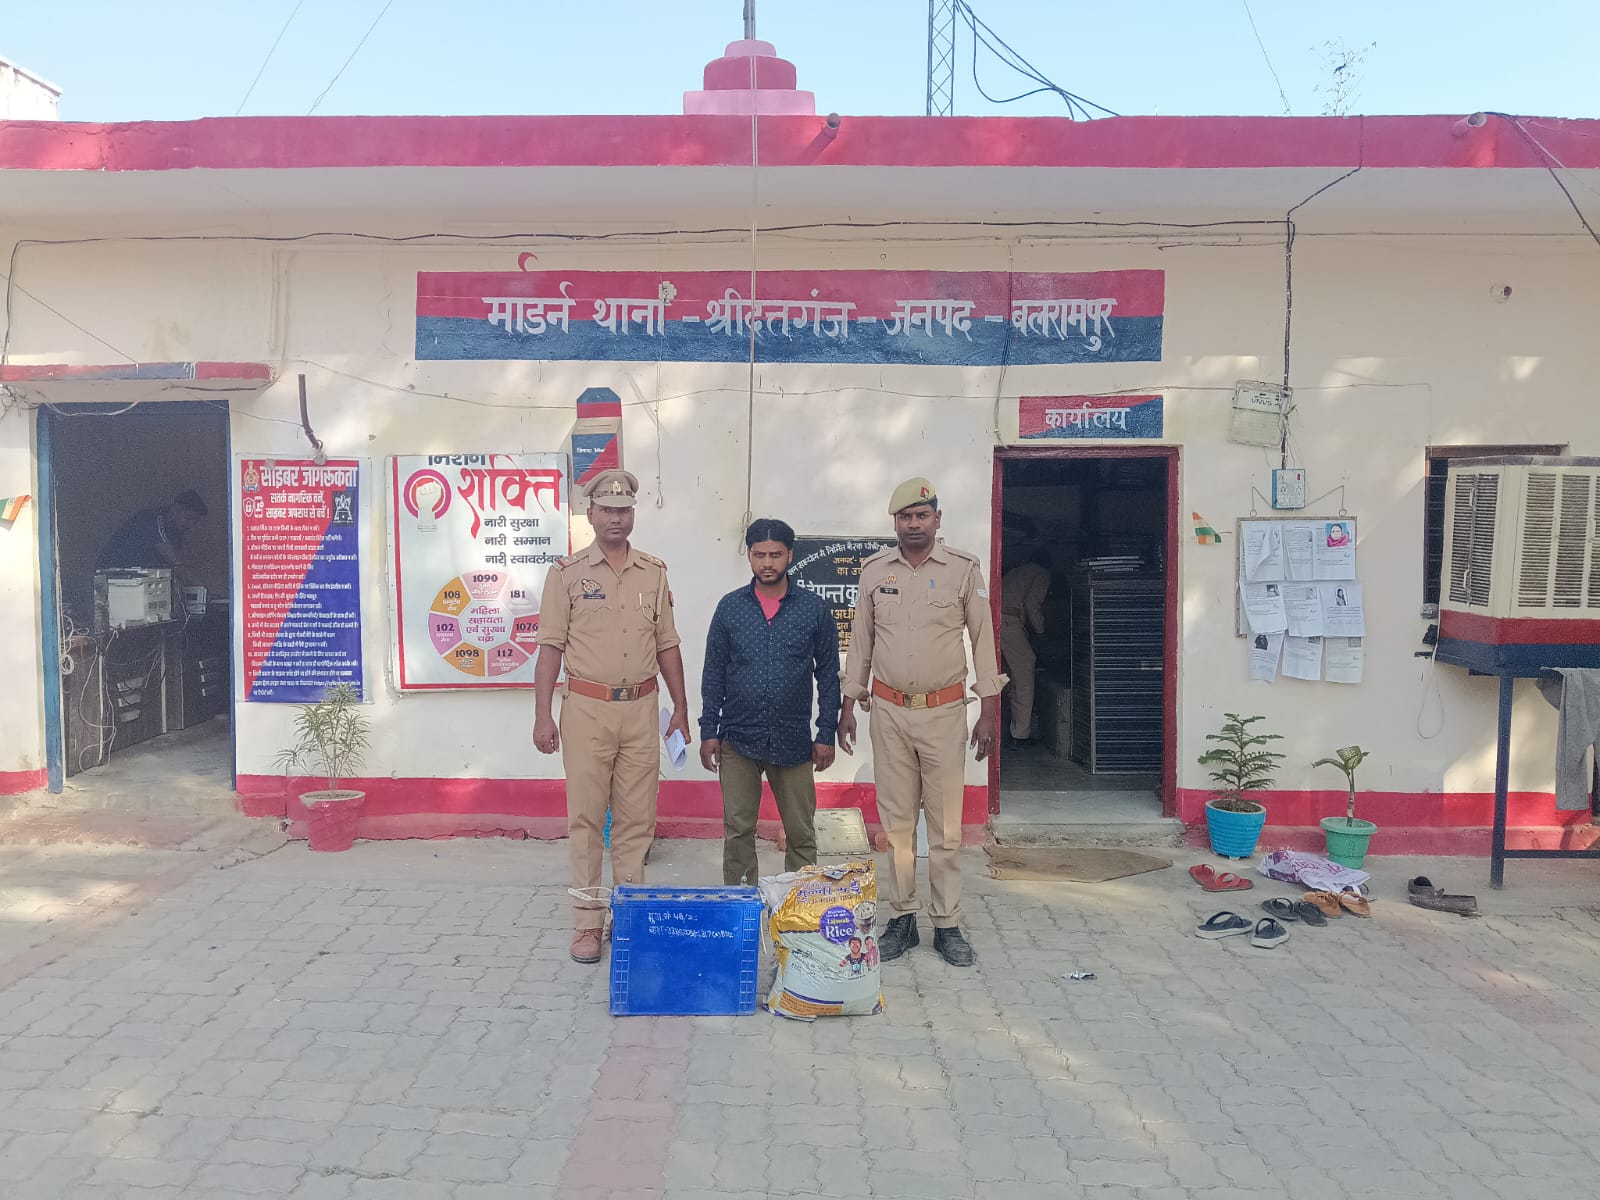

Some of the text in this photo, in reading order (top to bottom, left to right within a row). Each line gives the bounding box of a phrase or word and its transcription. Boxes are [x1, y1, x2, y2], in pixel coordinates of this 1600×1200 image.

[883, 298, 977, 341] जनपद
[1012, 298, 1118, 352] बलरामपुर
[1045, 402, 1131, 430] कार्यालय
[260, 466, 299, 488] साइबर
[457, 454, 563, 539] शक्ति
[484, 515, 539, 531] नारी सुरक्षा
[484, 533, 551, 546] नारी सम्मान
[485, 552, 507, 566] नारी
[473, 574, 498, 583] 1090
[443, 591, 460, 599] 108
[510, 589, 526, 598] 181
[471, 605, 500, 615] महिला
[468, 617, 503, 625] सहायता
[436, 623, 454, 632] 102
[516, 622, 539, 631] 1076
[455, 649, 480, 658] 1098
[497, 649, 513, 657] 112
[825, 926, 853, 938] Rice
